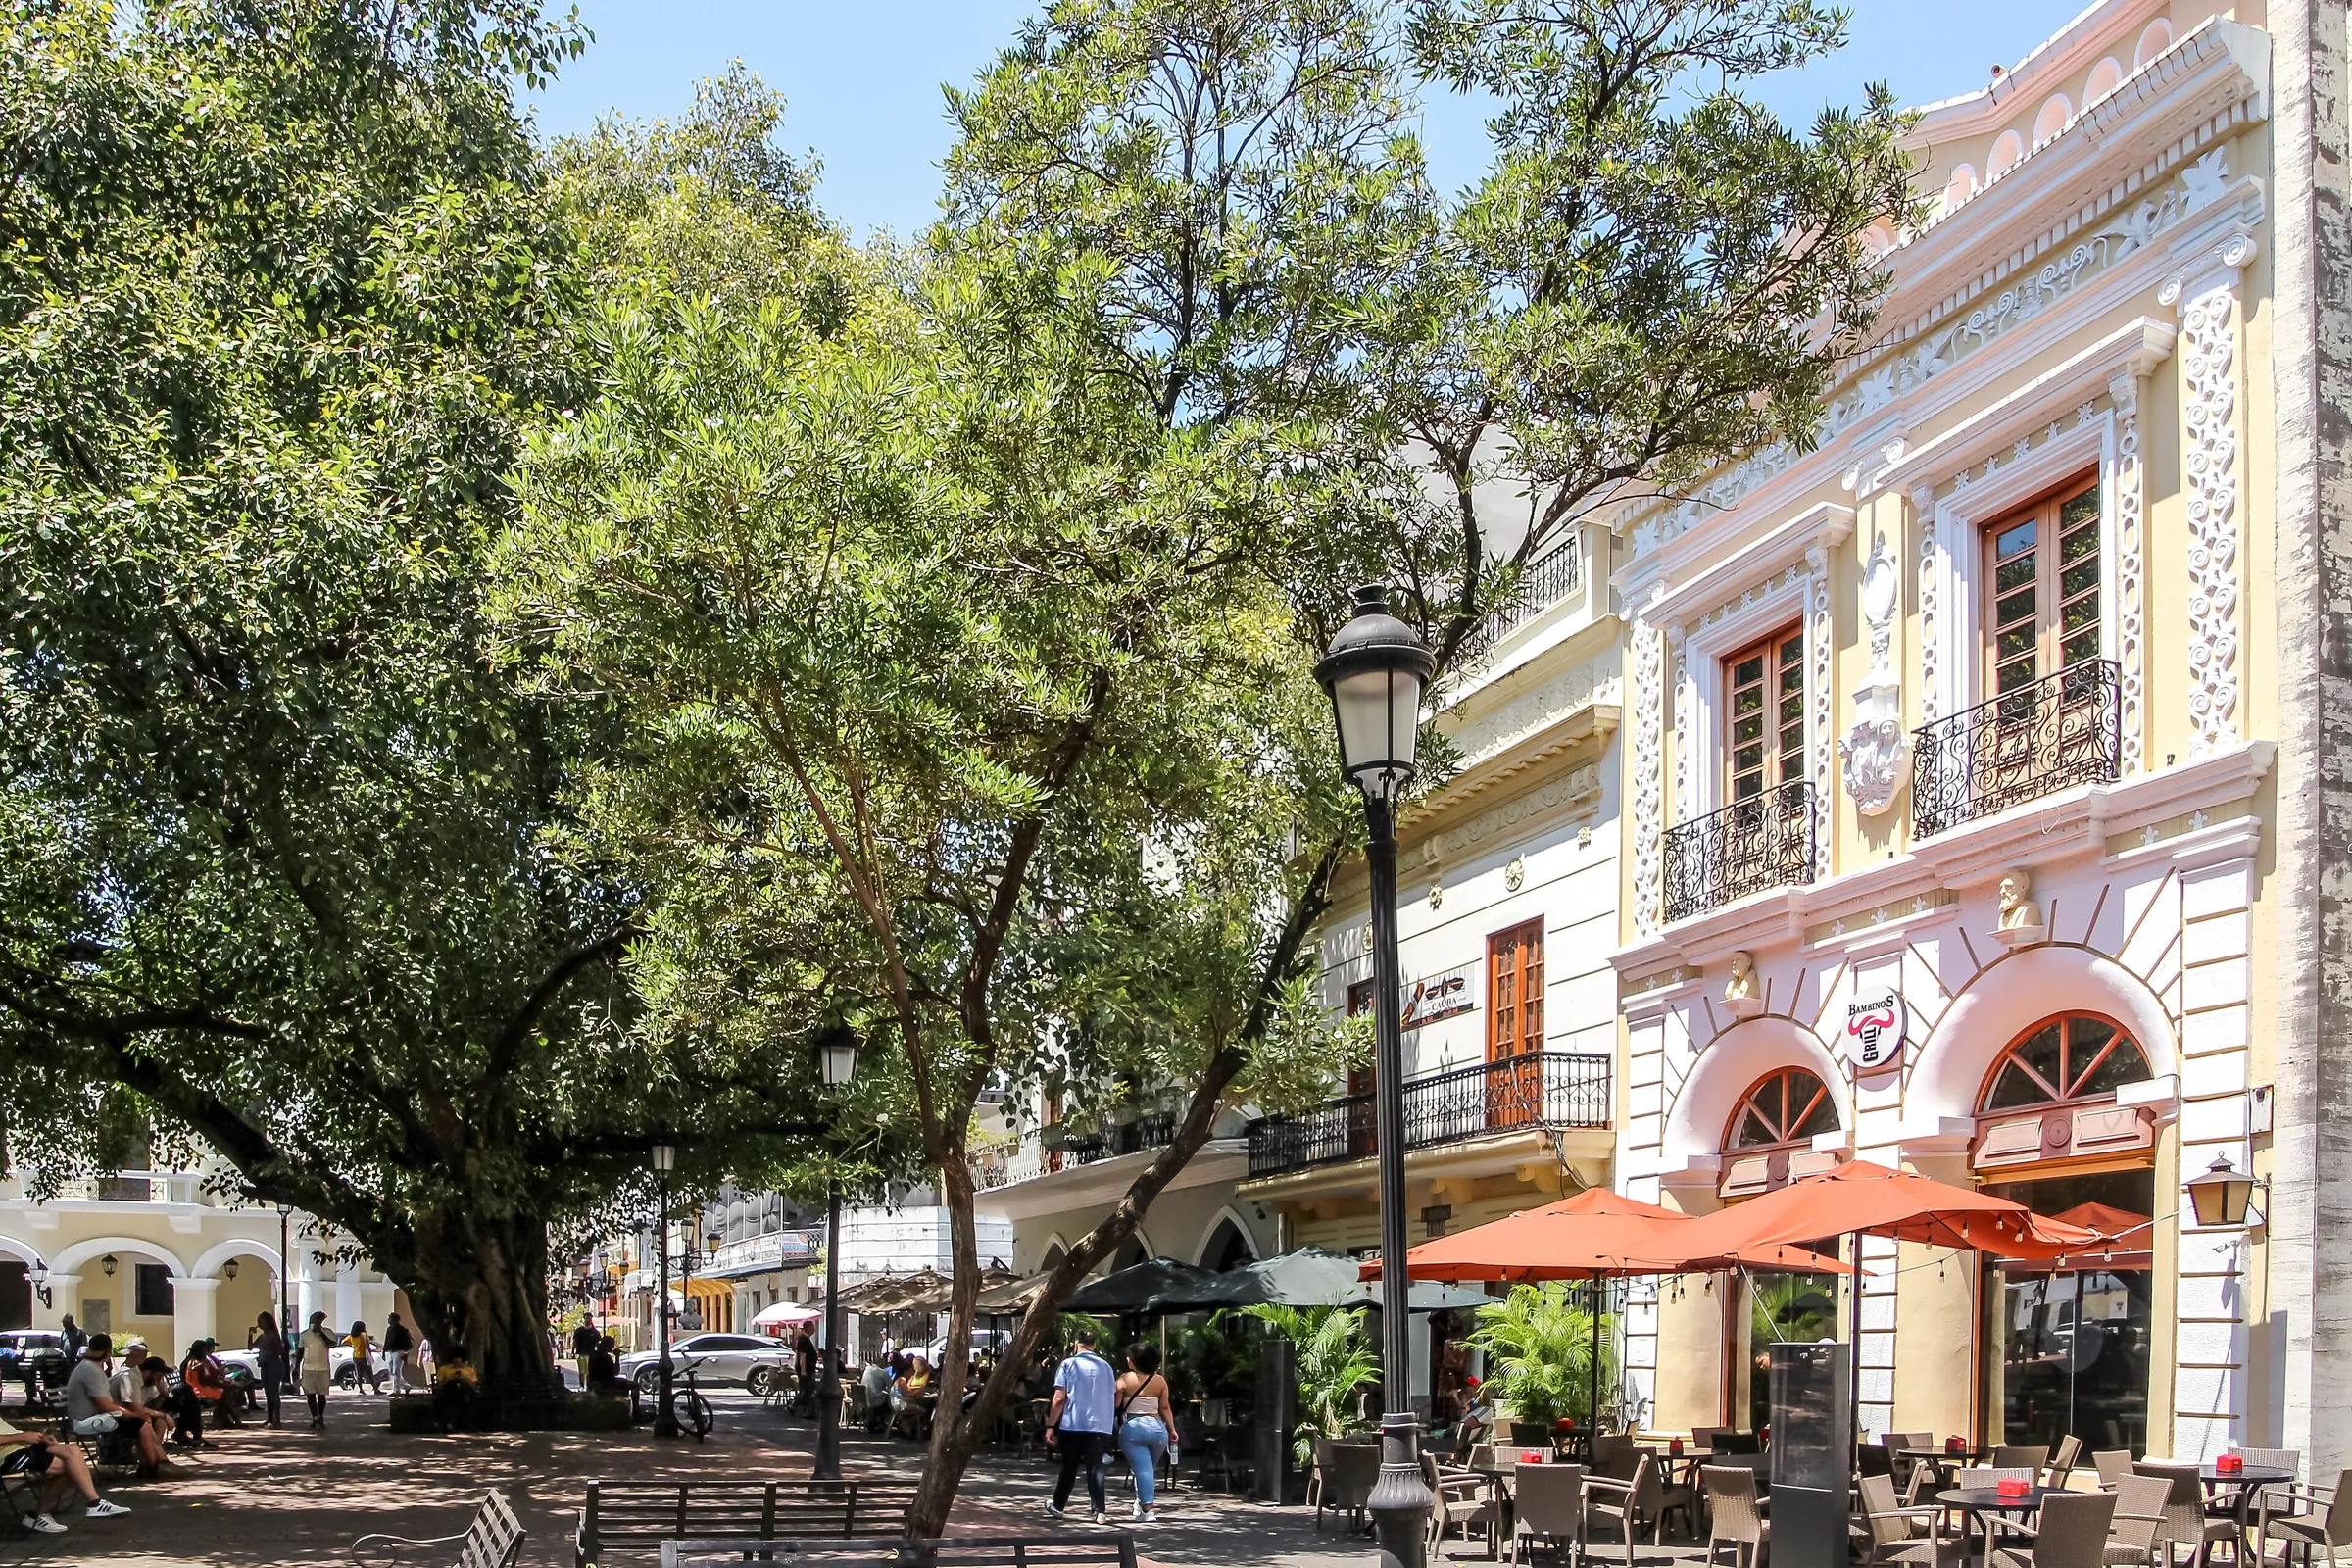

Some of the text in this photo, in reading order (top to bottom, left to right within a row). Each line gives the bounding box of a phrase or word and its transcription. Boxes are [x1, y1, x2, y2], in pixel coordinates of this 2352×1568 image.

[1432, 997, 1457, 1011] CAOBA
[1848, 995, 1894, 1017] BAMBINO'S
[1863, 1026, 1879, 1063] GRILL
